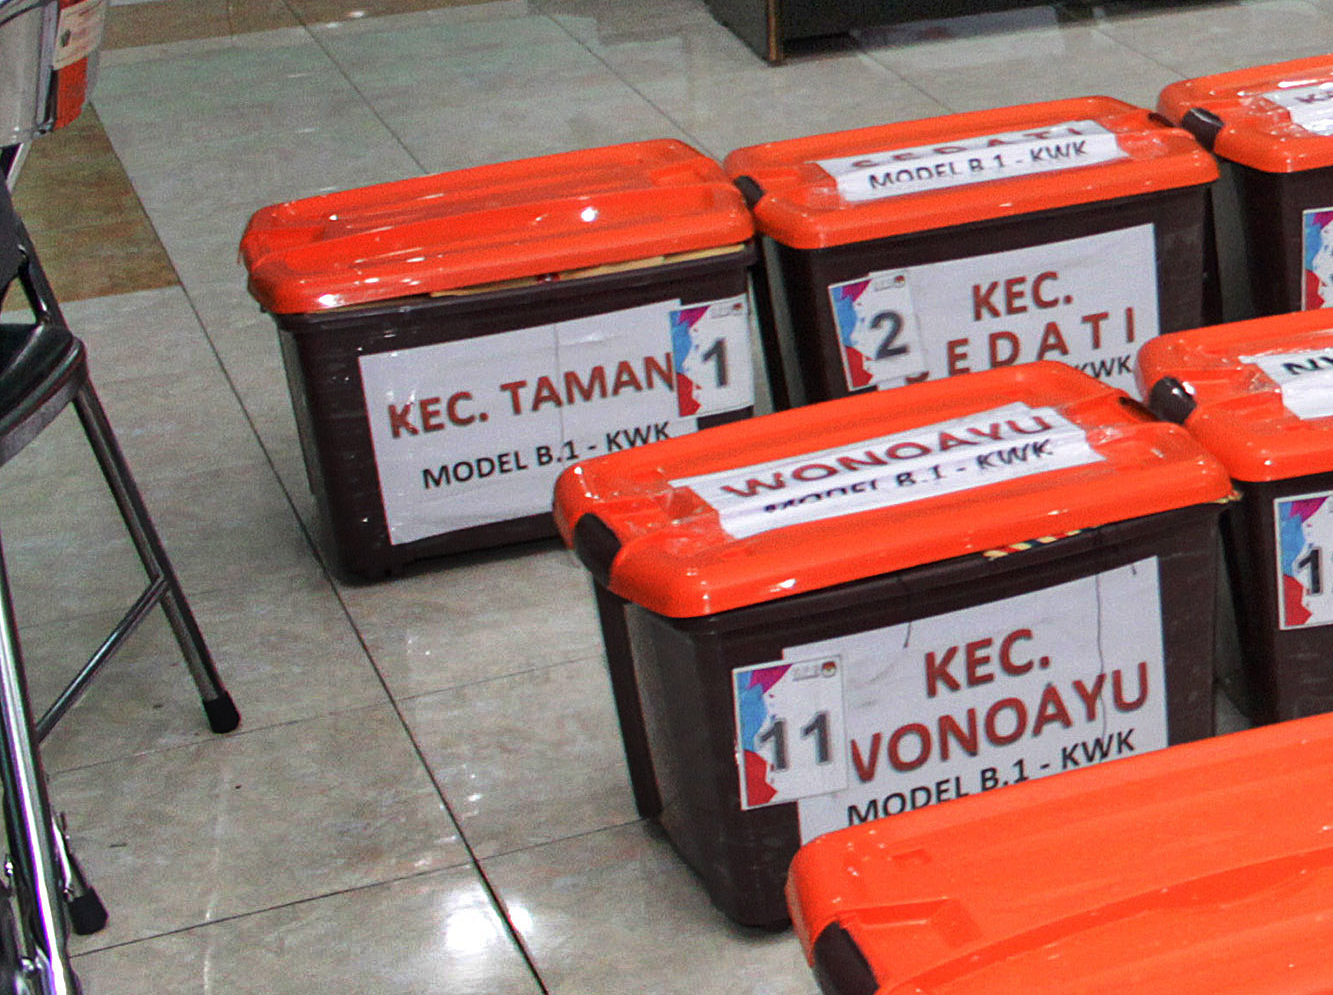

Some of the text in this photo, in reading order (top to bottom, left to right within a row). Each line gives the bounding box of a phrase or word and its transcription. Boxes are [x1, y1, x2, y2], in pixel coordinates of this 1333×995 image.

[1029, 140, 1087, 163] KWK
[971, 271, 1074, 322] KEC.
[701, 337, 730, 389] 1
[869, 310, 909, 361] 2
[388, 350, 680, 441] KEC. TAMAN
[421, 420, 671, 491] MODEL B.1 KWK
[719, 415, 1053, 499] WONOAYU
[975, 437, 1055, 471] KWK
[924, 627, 1051, 699] KEC.
[760, 710, 835, 773] 11
[847, 728, 1136, 826] MODEL B.1 KWK
